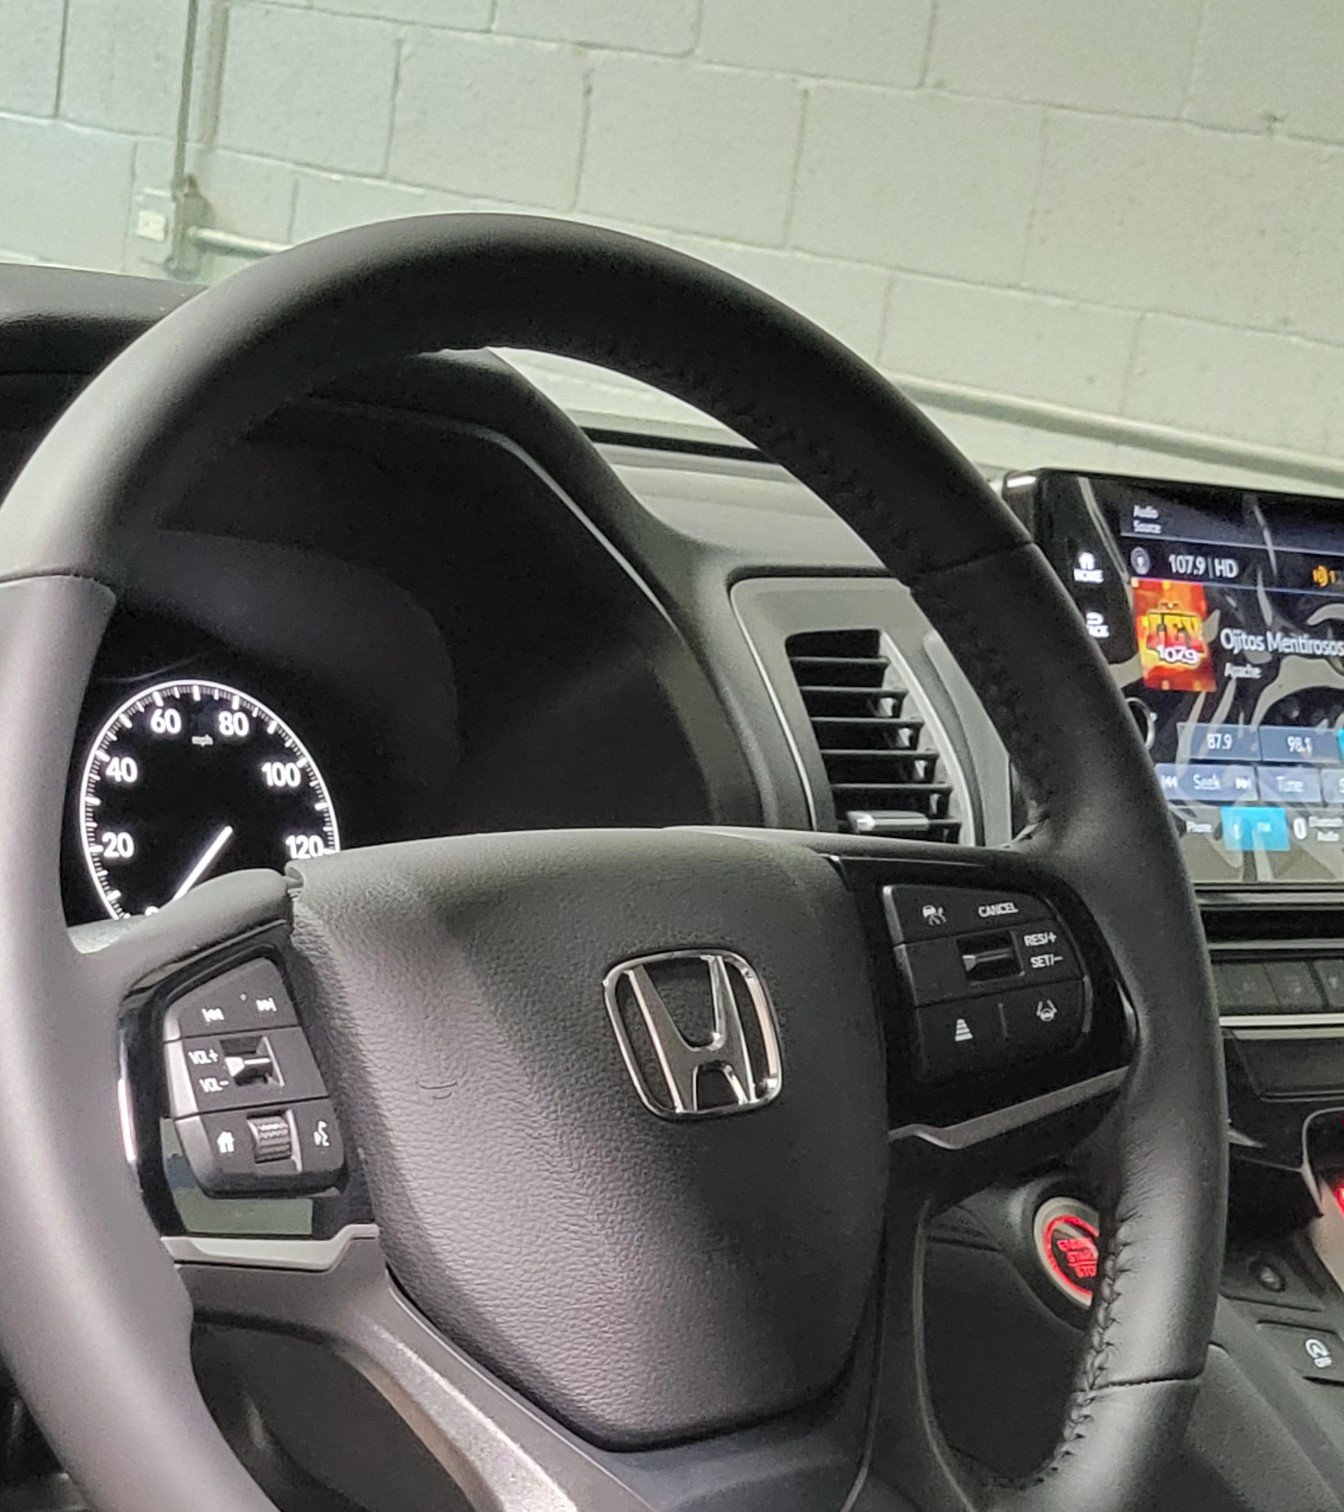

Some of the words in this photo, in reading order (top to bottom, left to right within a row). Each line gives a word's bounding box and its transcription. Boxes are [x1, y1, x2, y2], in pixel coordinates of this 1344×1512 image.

[1169, 554, 1206, 576] 107.9
[1214, 558, 1239, 578] HD
[1220, 628, 1265, 654] Ojitos
[150, 708, 182, 734] 60
[218, 711, 250, 736] 80
[1207, 733, 1233, 750] 87.9
[106, 757, 138, 783] 40
[261, 762, 301, 787] 100
[1193, 774, 1221, 790] Seek
[102, 832, 134, 858] 20
[285, 835, 325, 860] 120
[978, 902, 1019, 917] CANCEL
